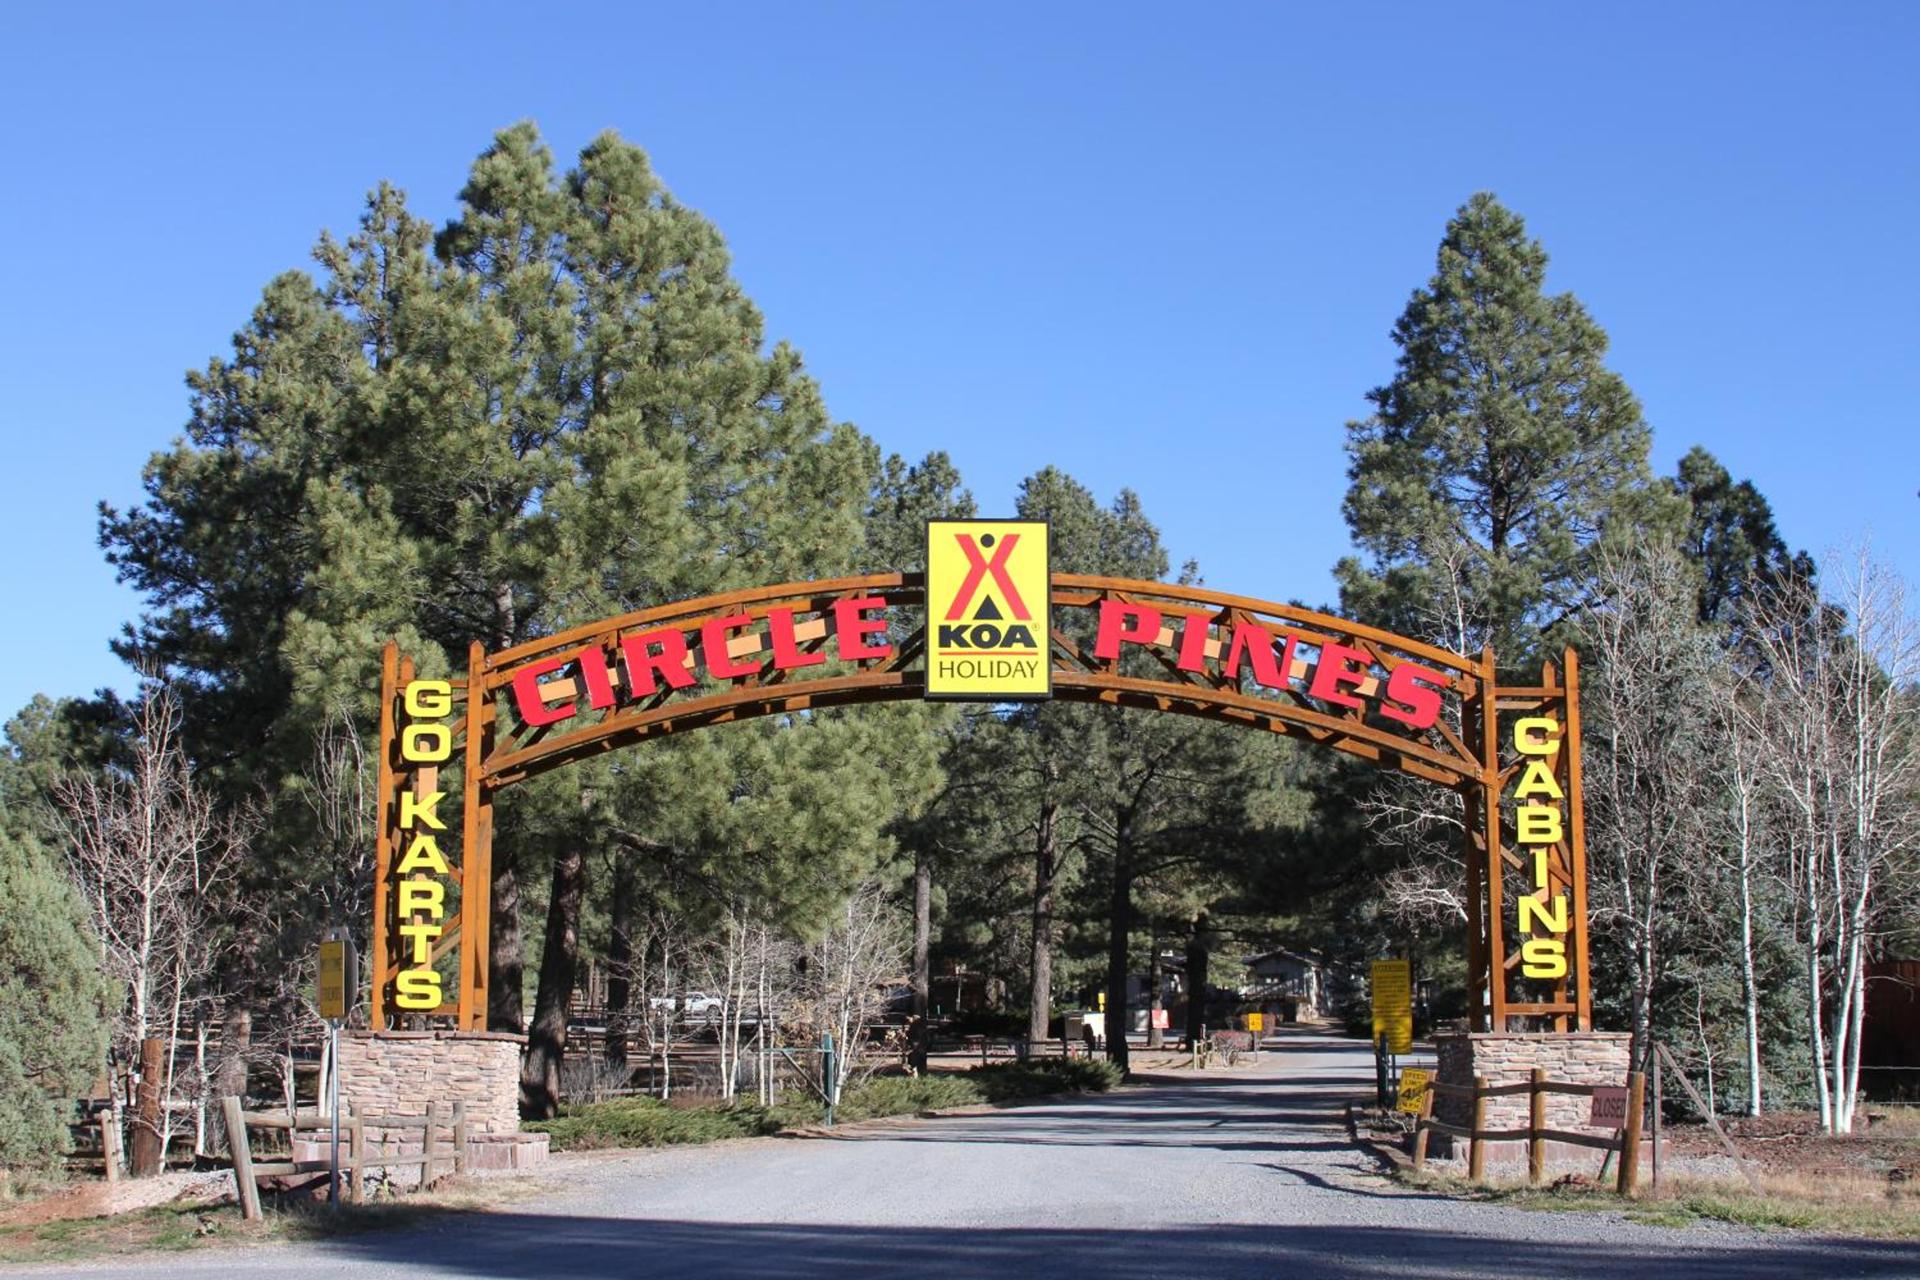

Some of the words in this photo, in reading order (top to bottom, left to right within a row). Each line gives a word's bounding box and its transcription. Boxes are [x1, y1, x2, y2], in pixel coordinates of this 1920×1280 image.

[512, 596, 893, 727] CIRCLE
[1095, 600, 1450, 729] PINES
[938, 624, 1037, 649] KOA
[939, 660, 1038, 678] HOLIDAY
[401, 680, 451, 761] GO
[1513, 717, 1568, 979] CABINS
[396, 792, 449, 1009] KARTS
[1592, 1097, 1626, 1118] CLOSED
